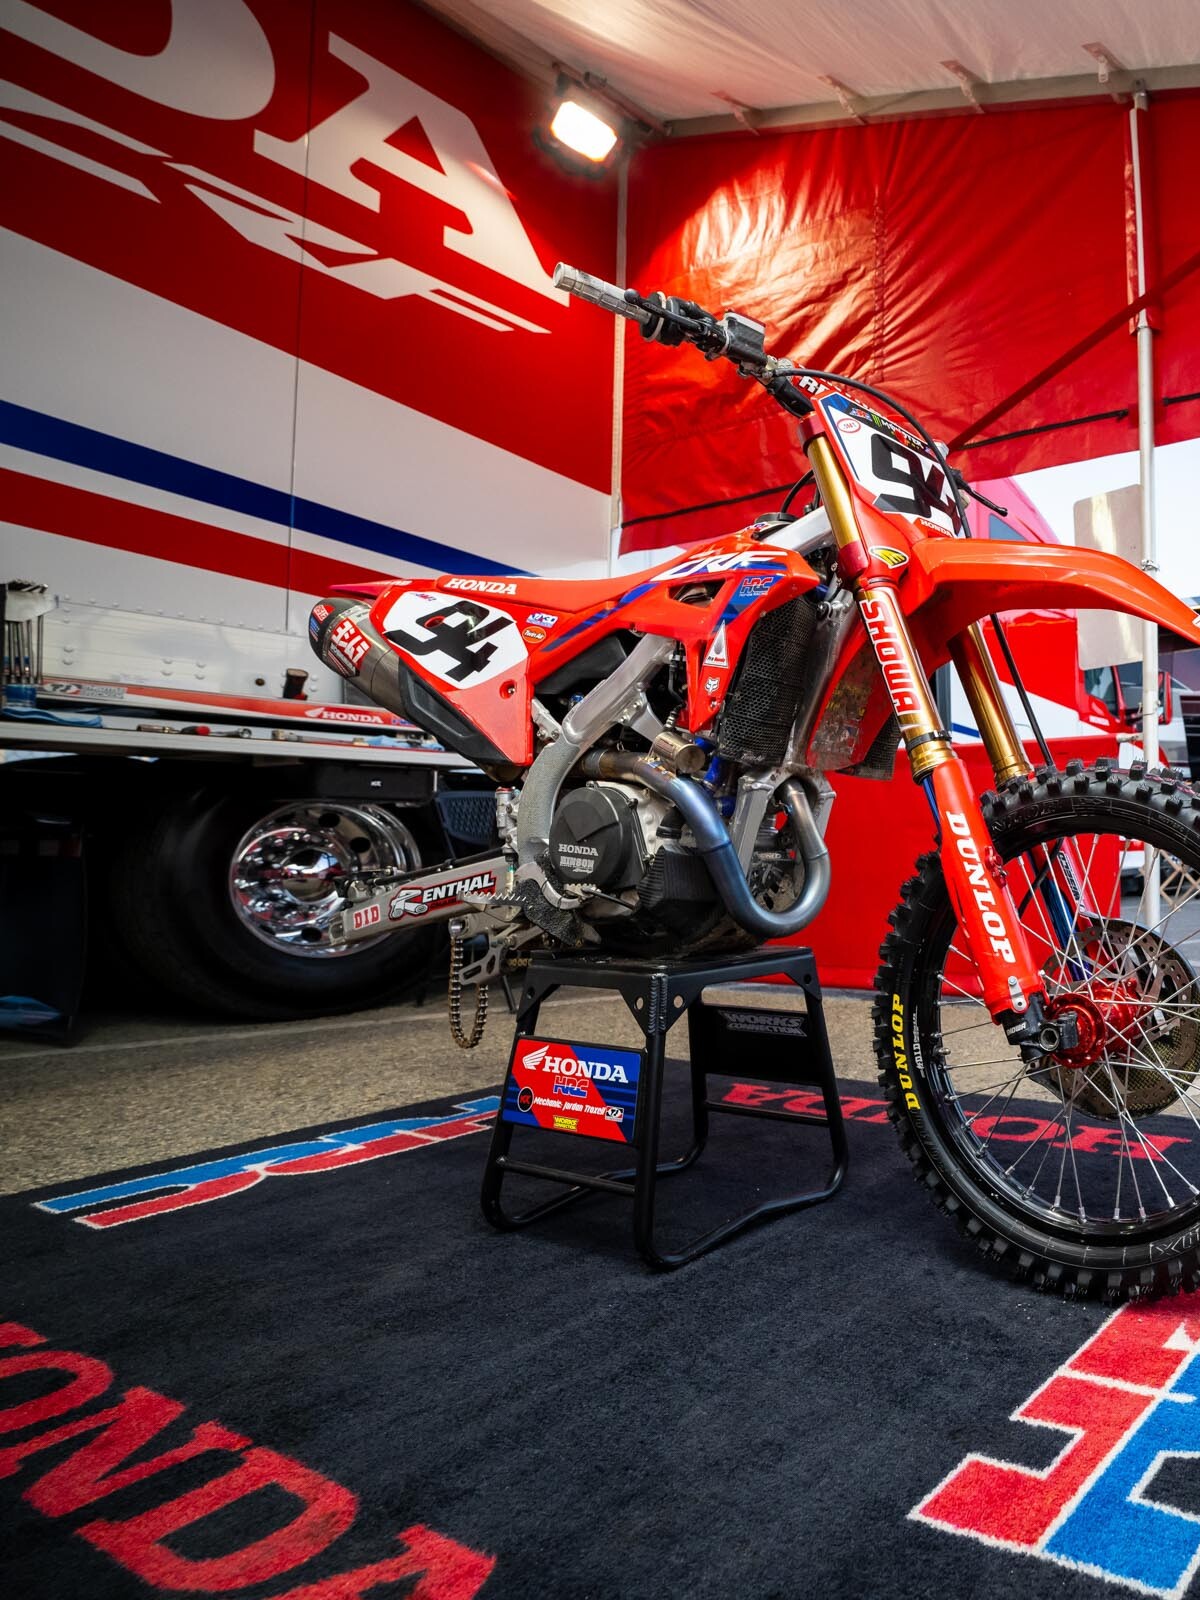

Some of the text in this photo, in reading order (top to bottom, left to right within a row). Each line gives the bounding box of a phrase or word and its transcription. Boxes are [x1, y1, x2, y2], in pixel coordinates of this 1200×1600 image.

[444, 577, 517, 595] HONDA
[741, 577, 774, 594] HRC
[384, 600, 516, 682] 94
[860, 599, 921, 716] SHOWA
[321, 711, 384, 724] HONDA
[558, 843, 598, 856] HONDA
[946, 810, 1016, 964] DUNLOP
[389, 872, 496, 921] RENTHAL
[726, 1012, 802, 1027] WORKS
[727, 1023, 802, 1036] CONNECTION
[891, 993, 921, 1110] DUNLOP
[543, 1055, 629, 1083] HONDA
[553, 1075, 589, 1098] HRC
[562, 1101, 583, 1112] Jordan
[583, 1104, 606, 1116] Troxell
[554, 1116, 578, 1126] WORKS
